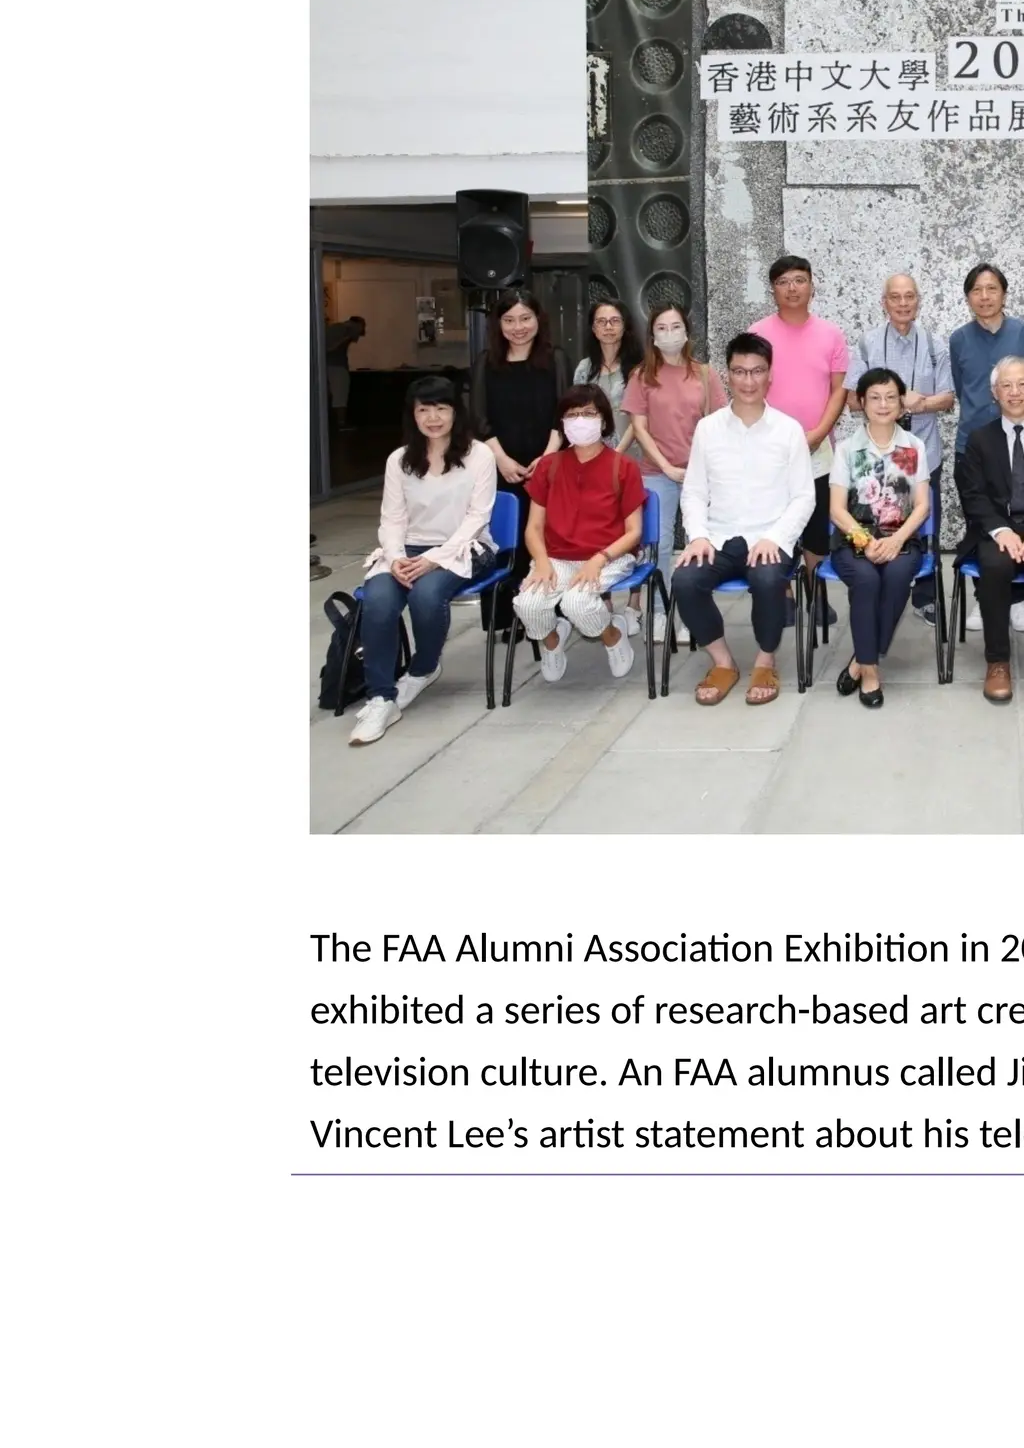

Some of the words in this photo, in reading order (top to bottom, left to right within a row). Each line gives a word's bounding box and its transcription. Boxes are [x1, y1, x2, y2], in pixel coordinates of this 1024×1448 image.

[707, 59, 930, 93] 香港中文大學
[309, 932, 372, 963] The
[383, 934, 447, 963] FAA
[455, 932, 573, 963] Alumni
[583, 932, 773, 963] Association
[785, 932, 948, 963] Exhibition
[961, 932, 989, 963] in
[310, 994, 464, 1025] exhibited
[476, 1002, 493, 1025] a
[505, 994, 601, 1025] series
[611, 994, 645, 1025] of
[656, 994, 908, 1025] research-based
[920, 996, 967, 1025] art
[310, 1056, 469, 1087] television
[480, 1056, 607, 1087] culture.
[618, 1058, 662, 1086] An
[675, 1058, 738, 1086] FAA
[747, 1056, 890, 1087] alumnus
[900, 1056, 996, 1087] called
[309, 1118, 438, 1149] Vincent
[448, 1117, 529, 1149] Lee’s
[539, 1118, 625, 1149] artist
[635, 1120, 805, 1149] statement
[815, 1118, 913, 1149] about
[924, 1118, 969, 1149] his
